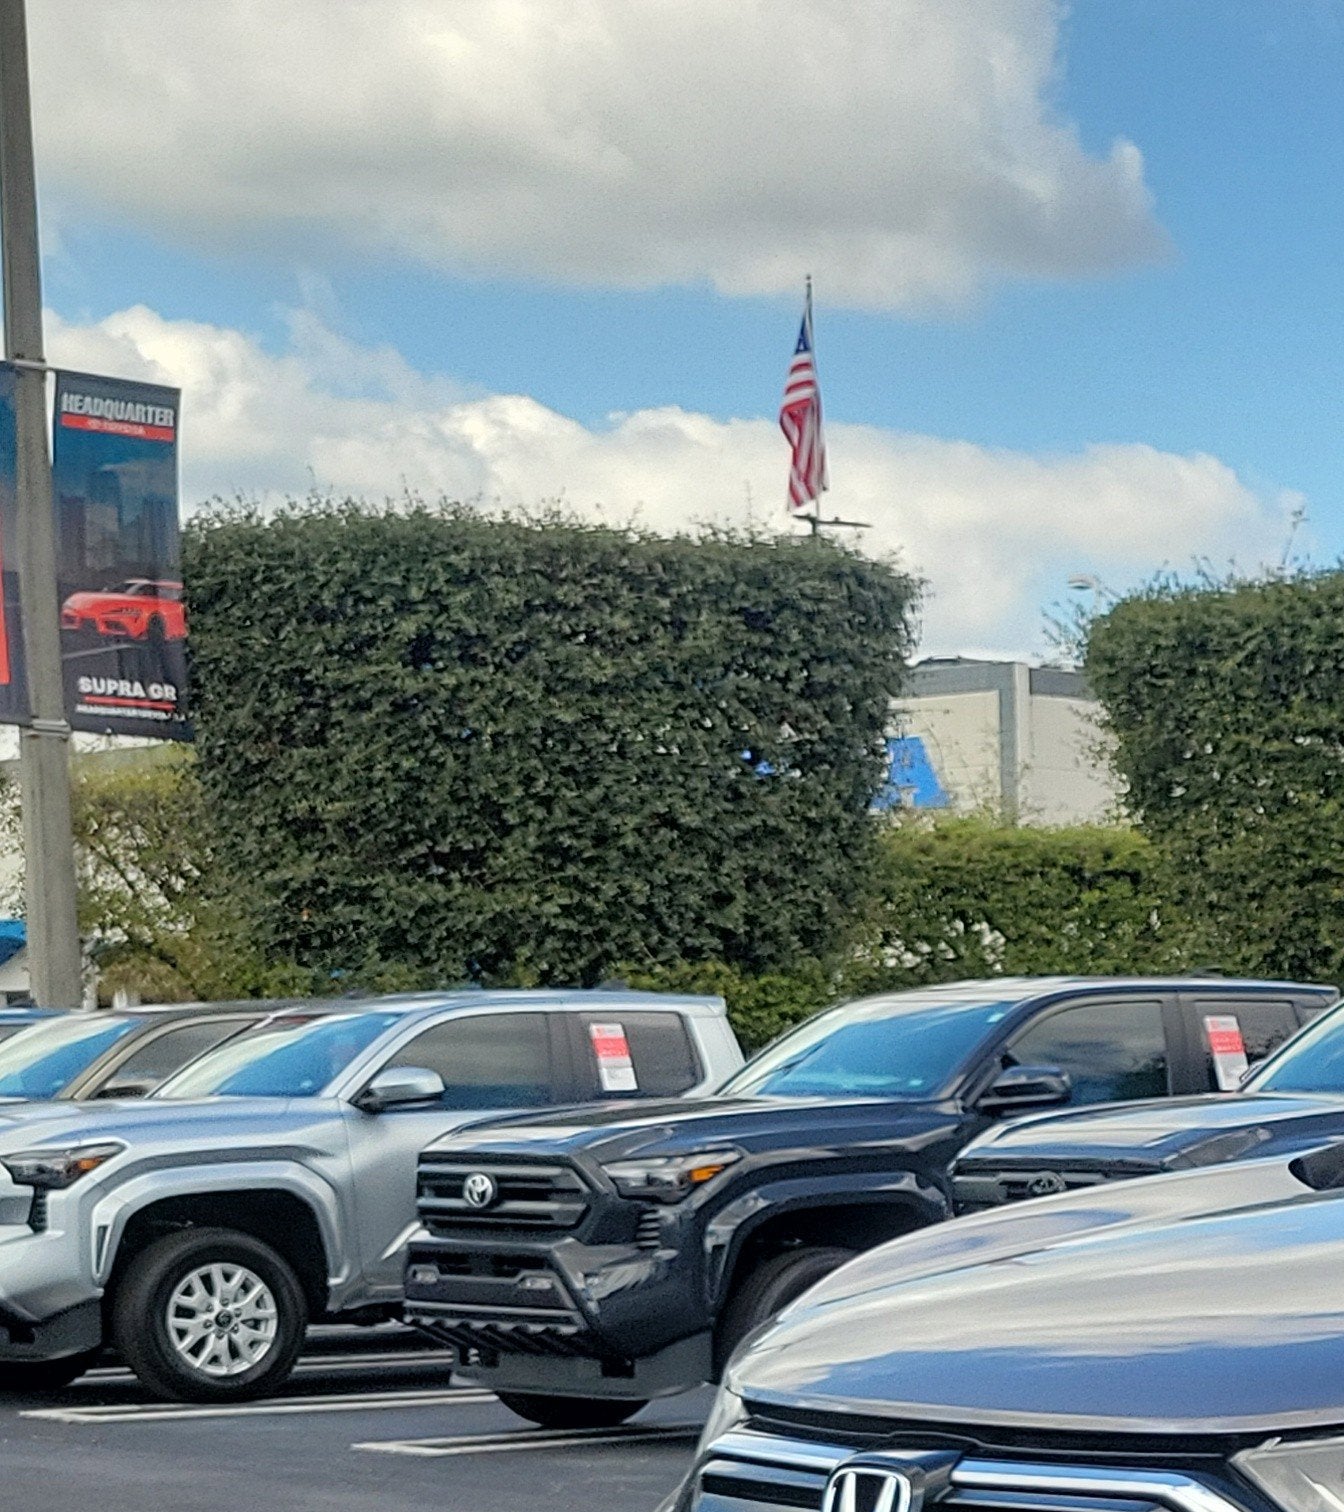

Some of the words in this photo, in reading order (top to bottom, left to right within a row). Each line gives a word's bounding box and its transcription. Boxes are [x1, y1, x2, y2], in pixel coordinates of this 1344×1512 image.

[62, 391, 175, 427] HEADQUARTER
[77, 675, 147, 698] SUPRA
[149, 682, 178, 701] GR
